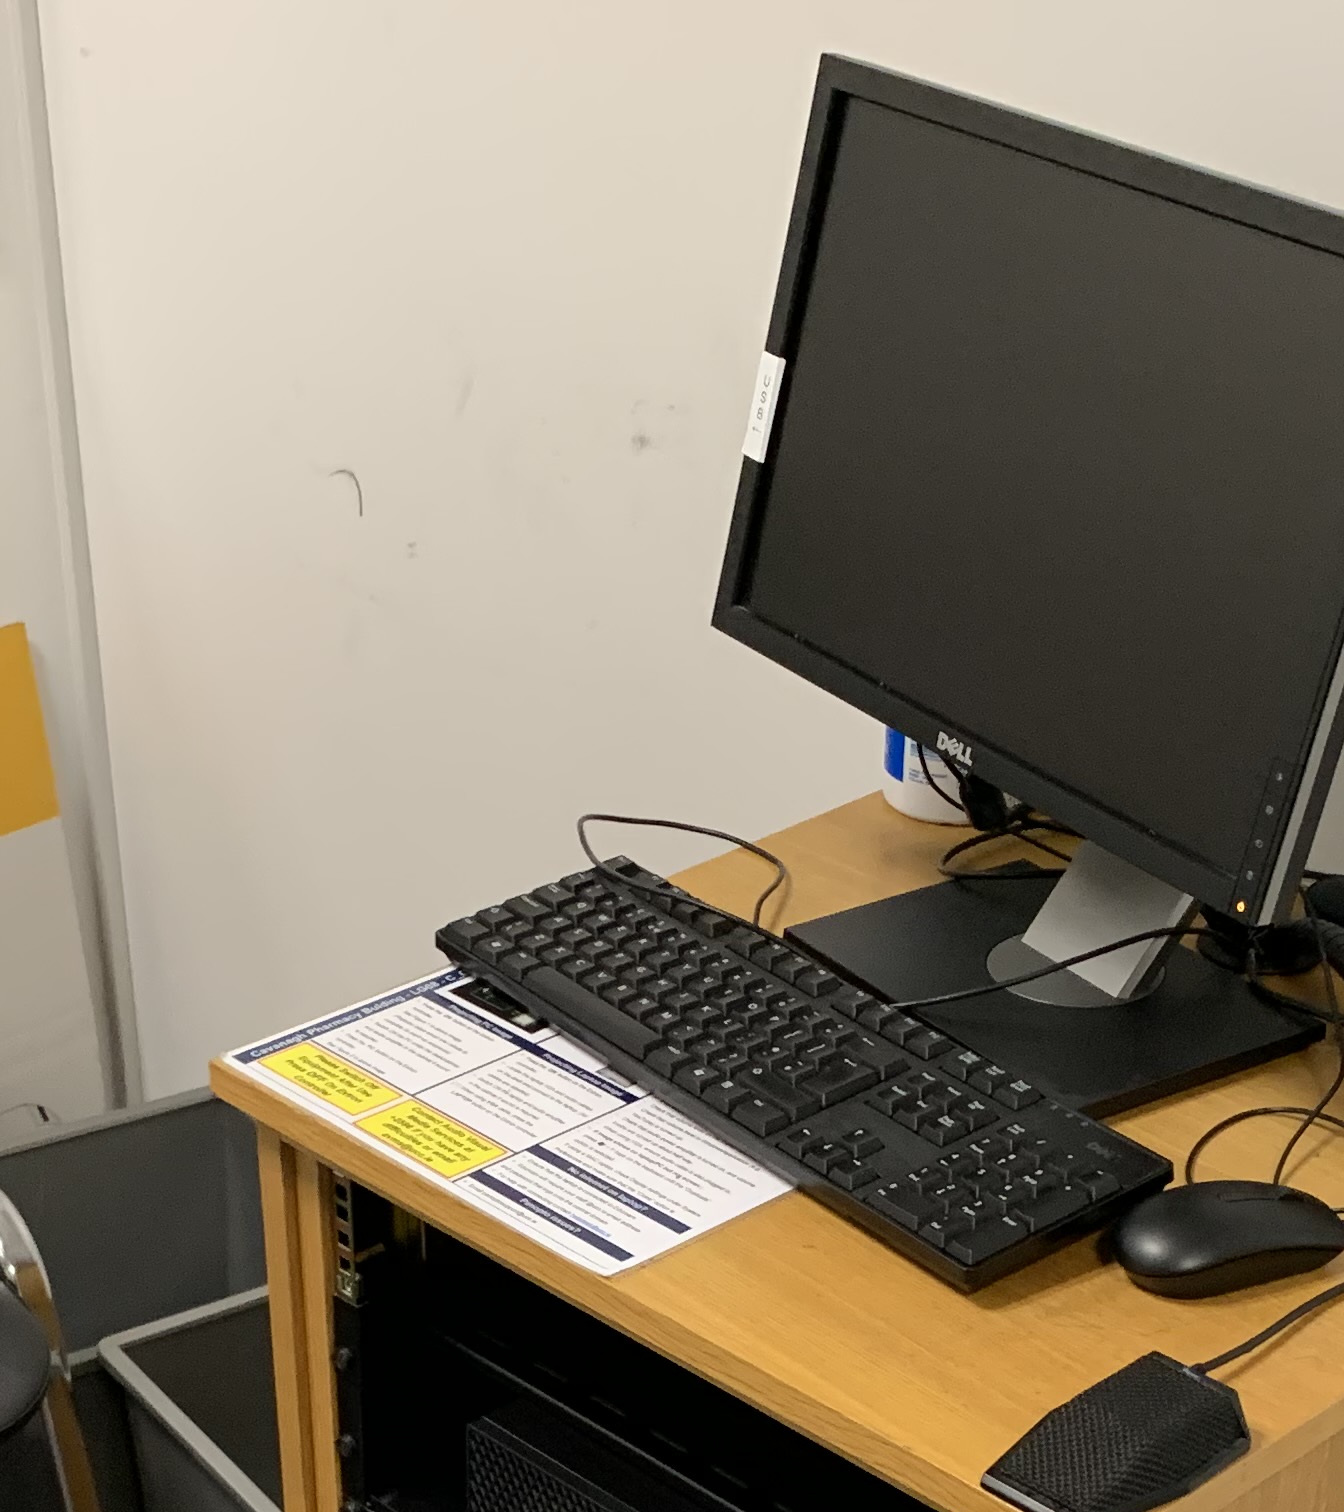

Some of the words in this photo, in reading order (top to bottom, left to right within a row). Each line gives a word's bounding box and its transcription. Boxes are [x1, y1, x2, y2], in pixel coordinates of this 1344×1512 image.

[936, 730, 973, 767] DELL
[250, 1032, 307, 1058] Cavanagh
[309, 1009, 363, 1036] Pharmacy
